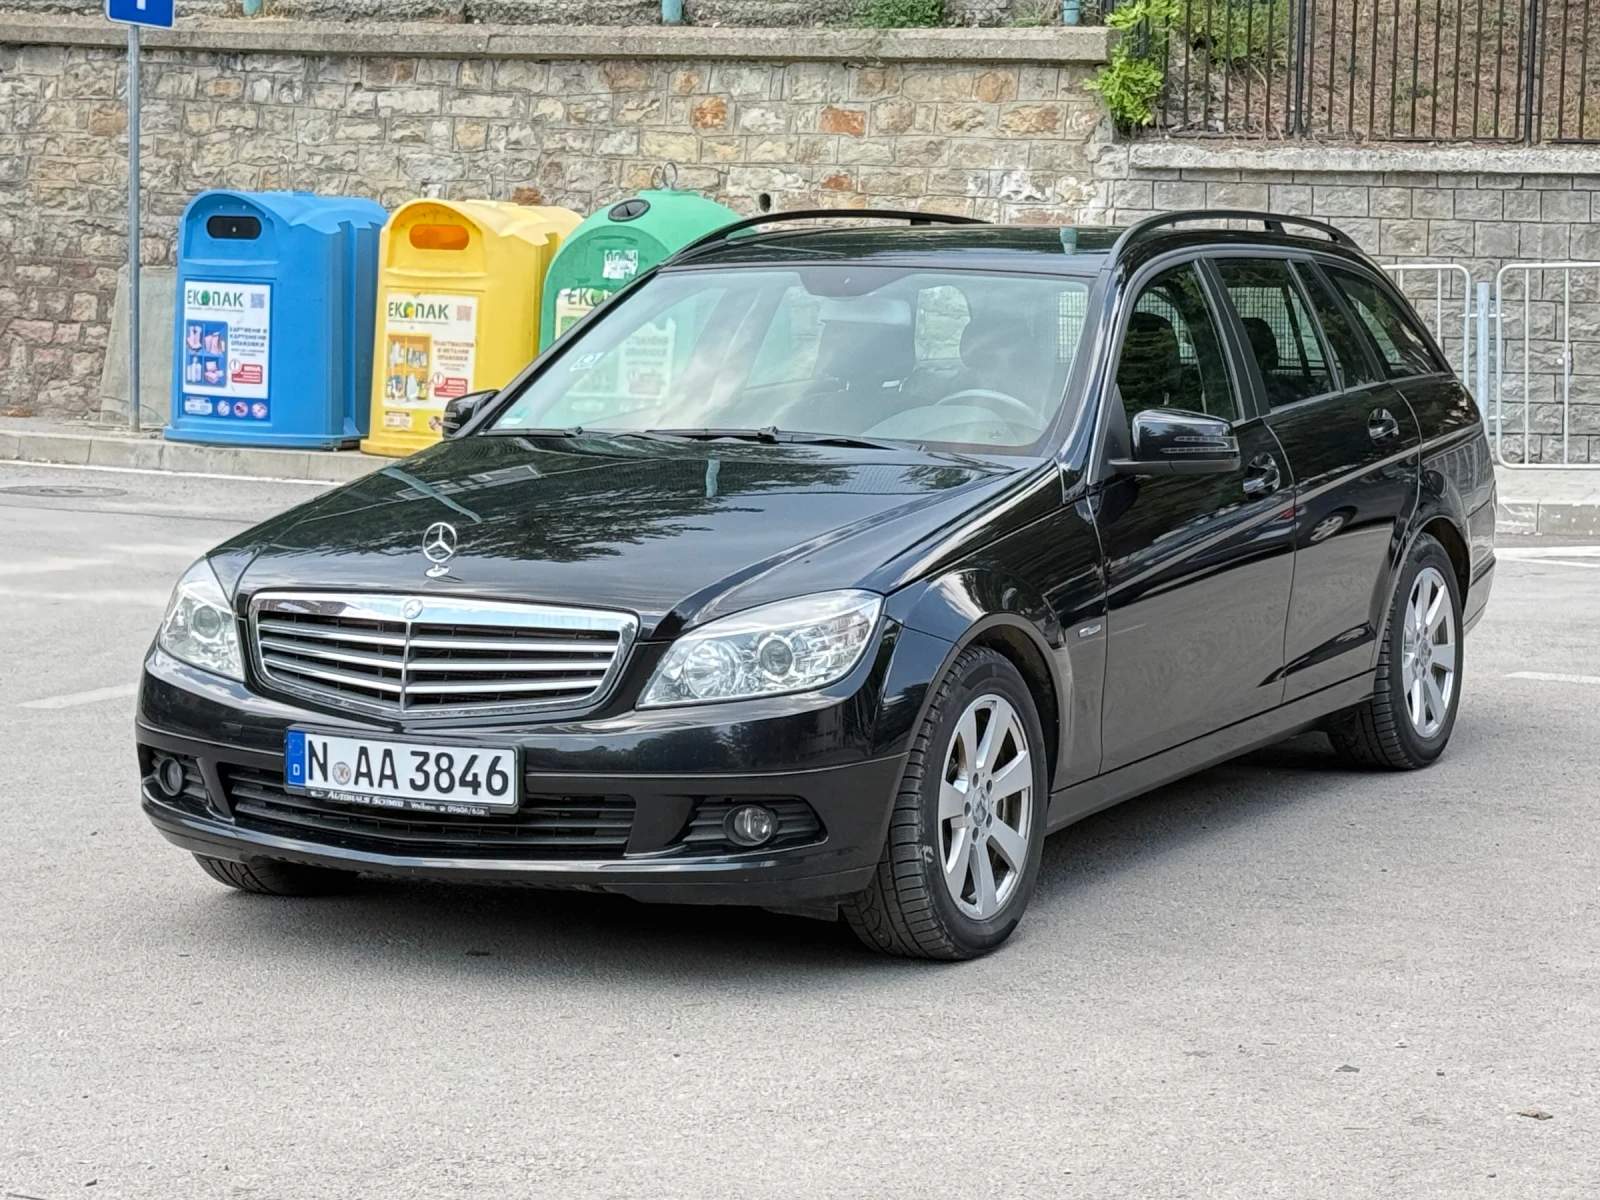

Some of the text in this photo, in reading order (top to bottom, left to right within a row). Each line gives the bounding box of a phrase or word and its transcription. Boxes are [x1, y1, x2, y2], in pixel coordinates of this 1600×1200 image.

[186, 289, 244, 308] ЕКОПАК
[388, 301, 450, 320] ЕКОПАК
[293, 763, 300, 776] D
[308, 740, 509, 797] N AA 3846
